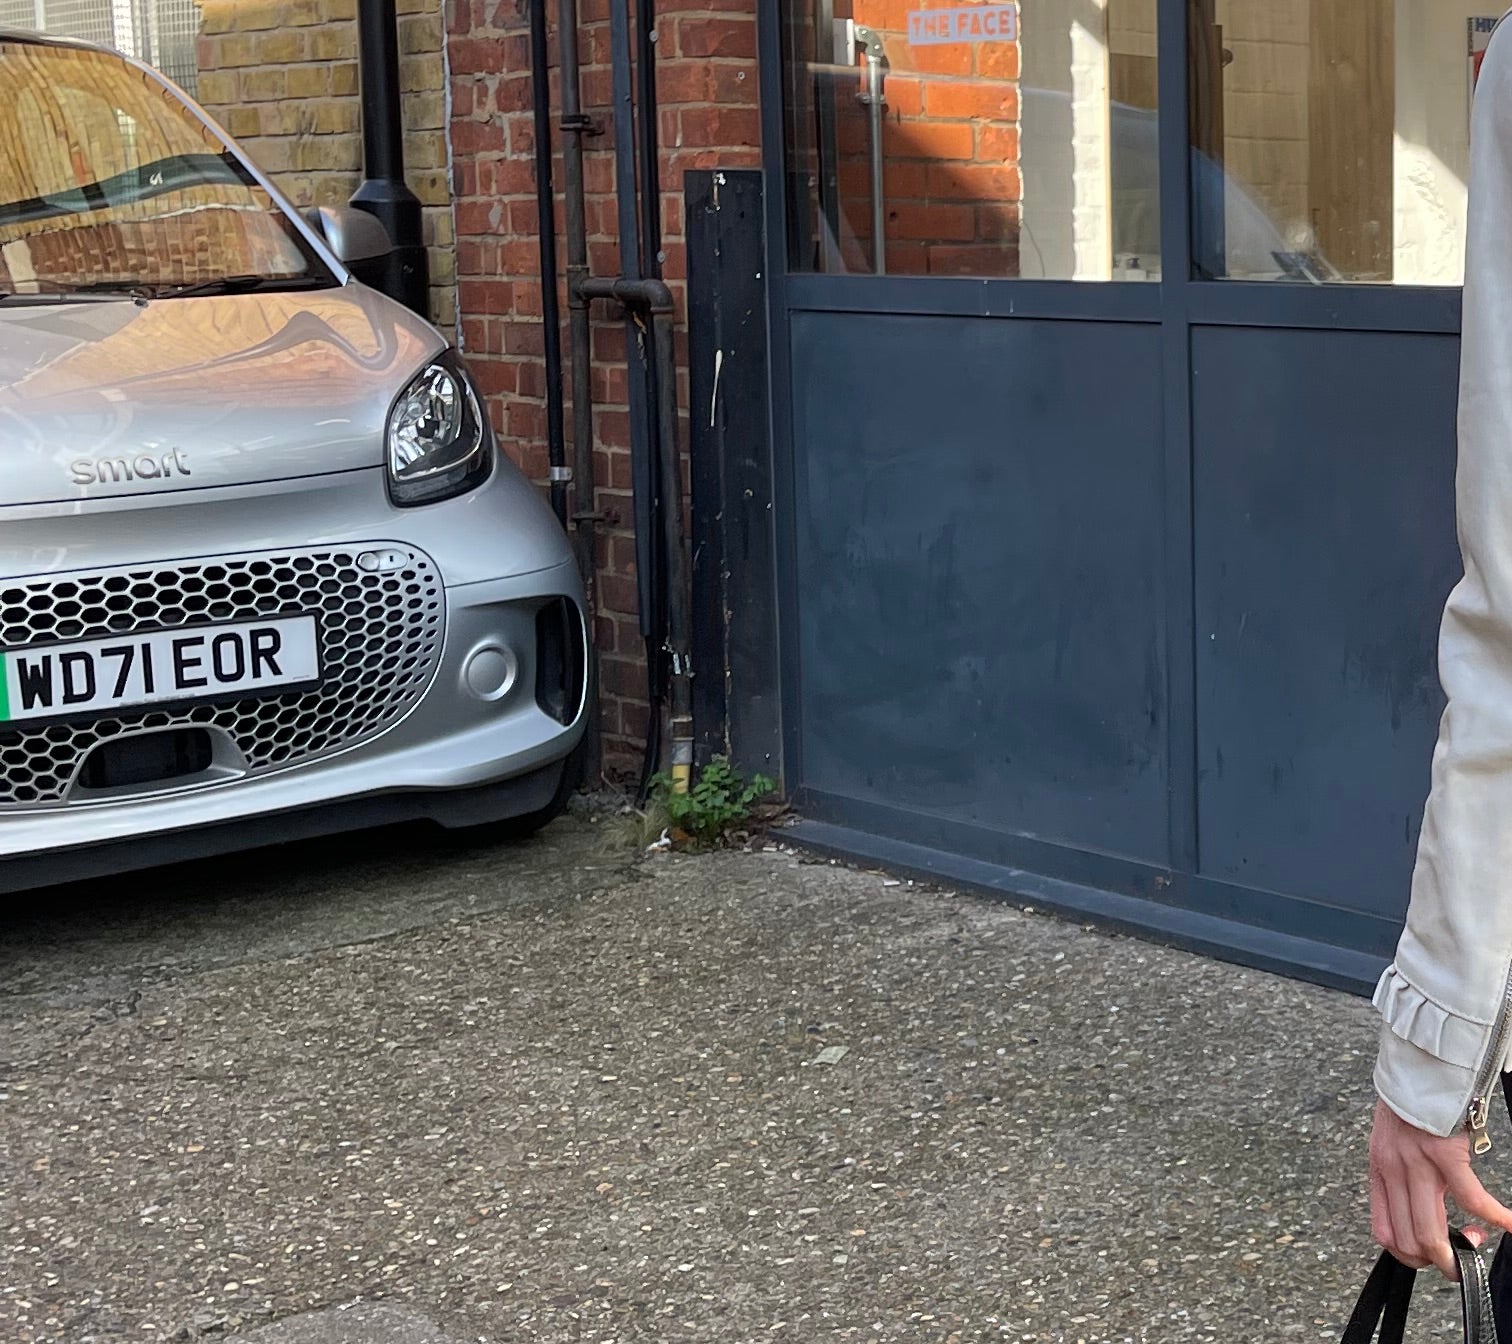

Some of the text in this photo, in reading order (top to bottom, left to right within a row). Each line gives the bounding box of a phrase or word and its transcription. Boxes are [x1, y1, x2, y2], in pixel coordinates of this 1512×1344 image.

[911, 9, 1011, 39] THE FACE
[70, 447, 191, 485] smart
[17, 627, 283, 710] WD71 EOR
